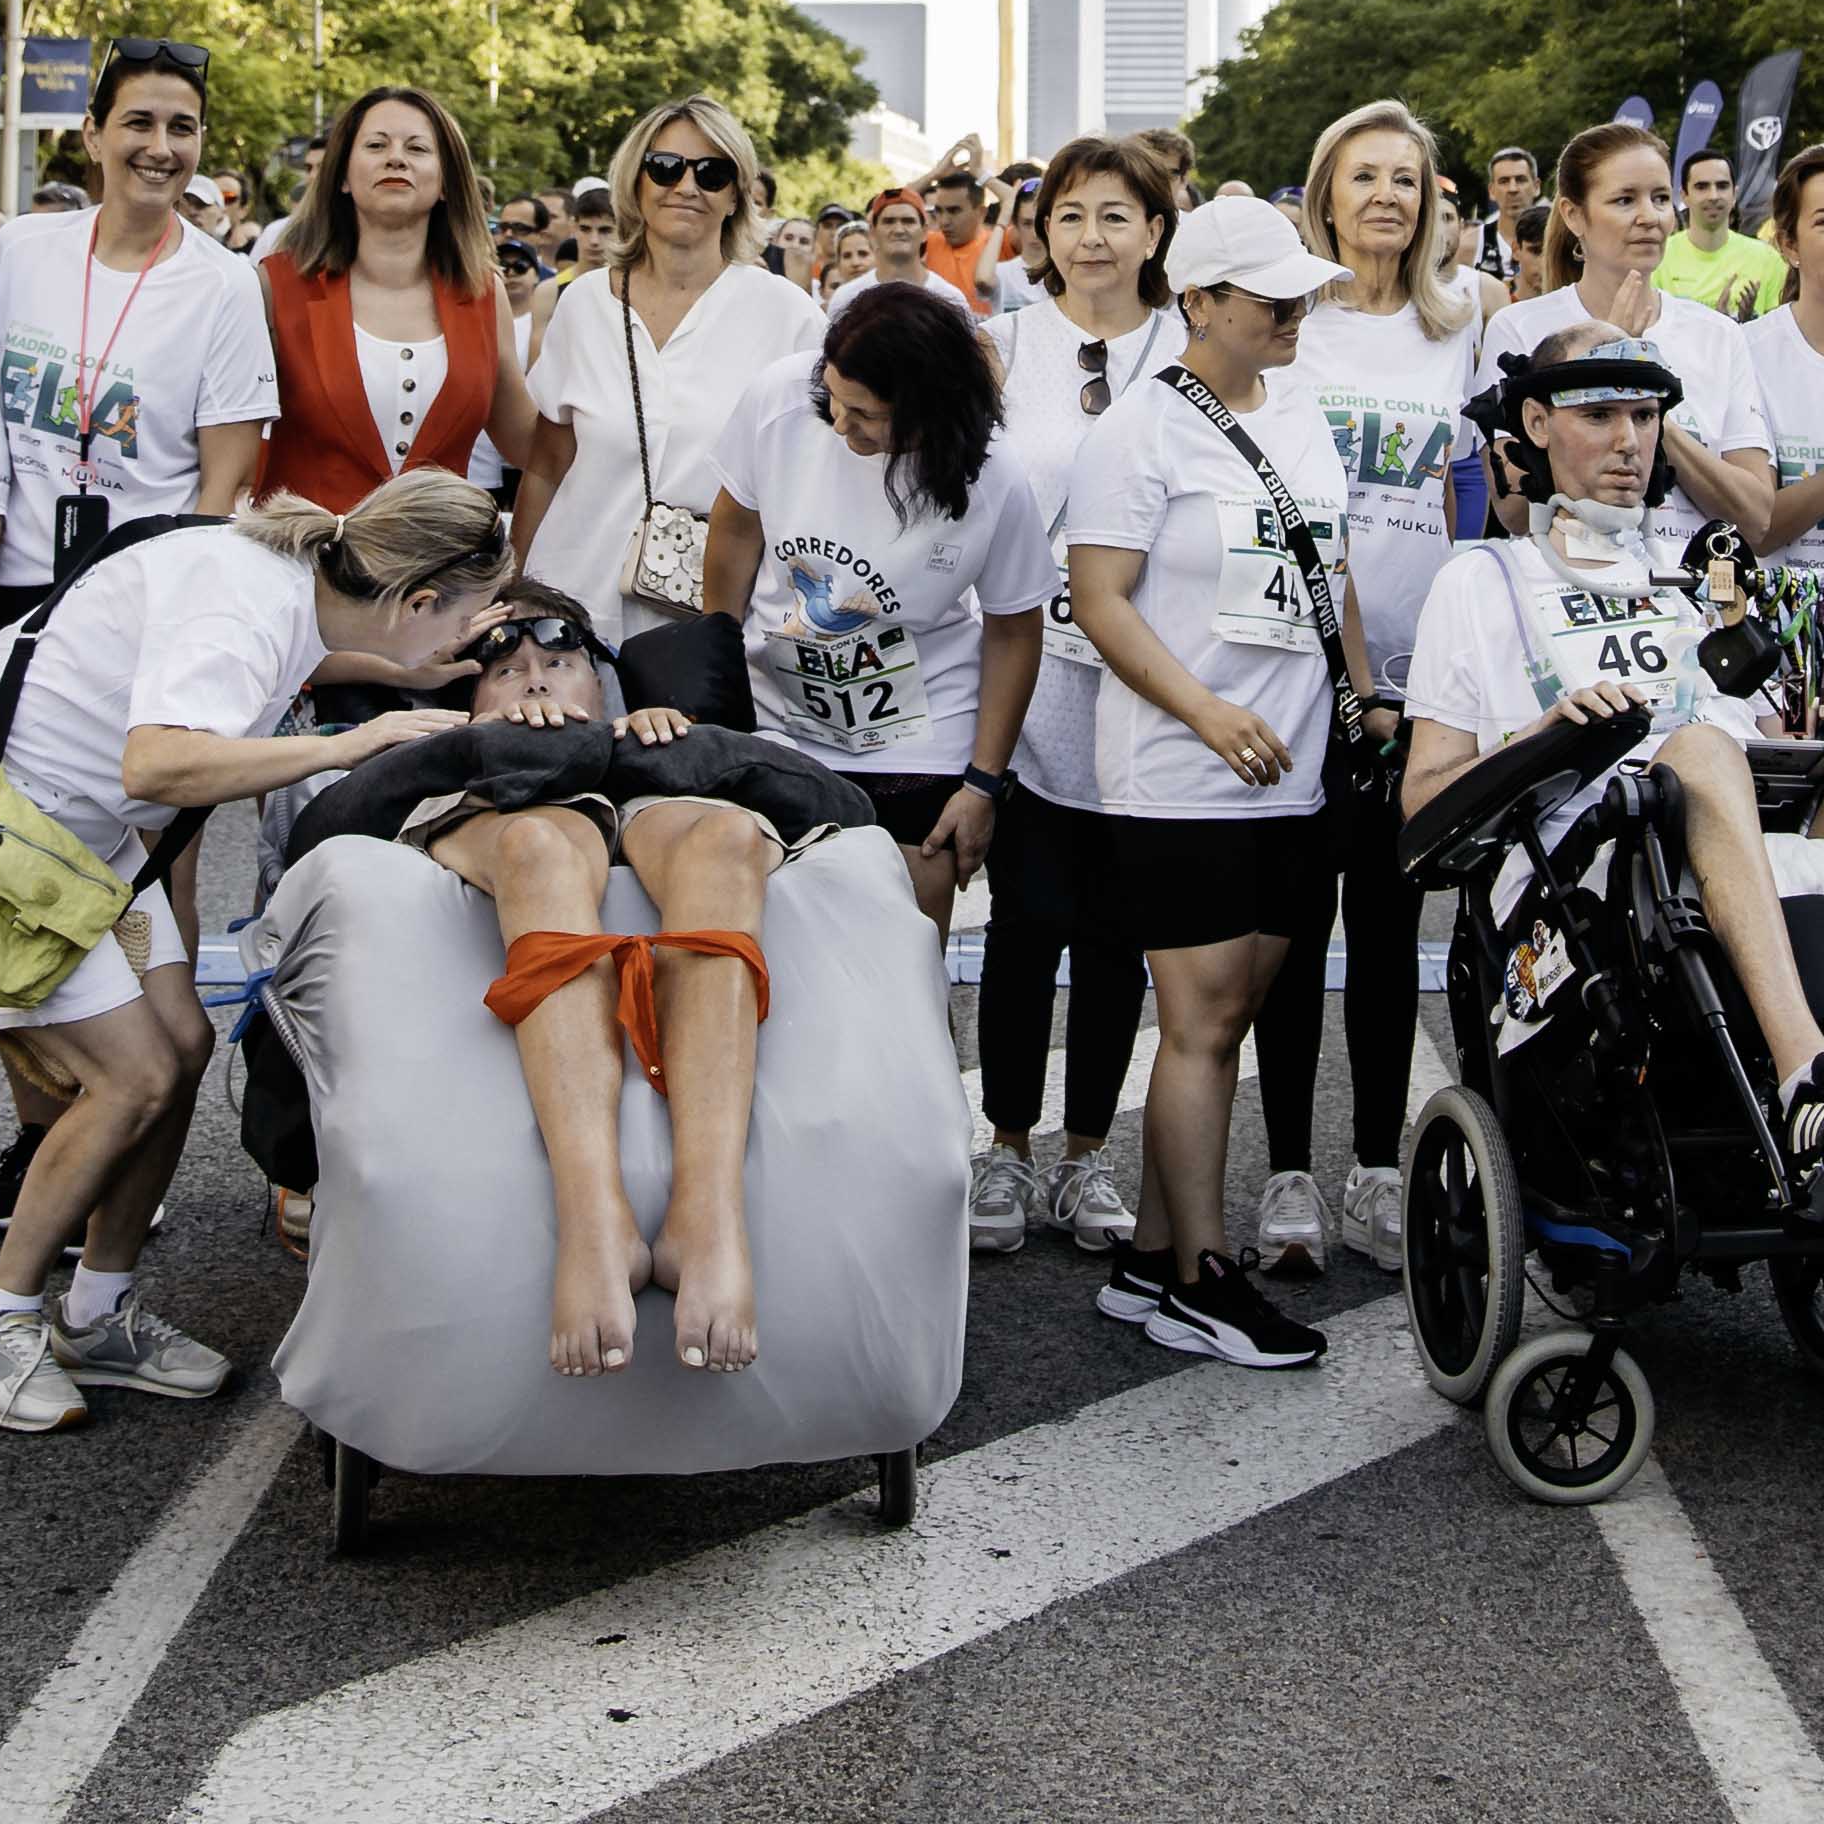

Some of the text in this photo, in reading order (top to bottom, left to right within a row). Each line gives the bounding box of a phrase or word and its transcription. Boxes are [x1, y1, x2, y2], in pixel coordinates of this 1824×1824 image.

[5, 333, 68, 360] MADRID
[112, 364, 134, 382] LA
[1176, 371, 1236, 429] BIMBA
[1384, 398, 1425, 415] CON
[1431, 403, 1450, 418] LA
[1256, 457, 1302, 530] BIMBA
[774, 536, 902, 616] CORREDORES
[1307, 562, 1337, 639] BIMBA
[830, 639, 852, 652] CON
[851, 634, 865, 644] LA
[1597, 630, 1668, 678] 46
[801, 680, 900, 729] 512
